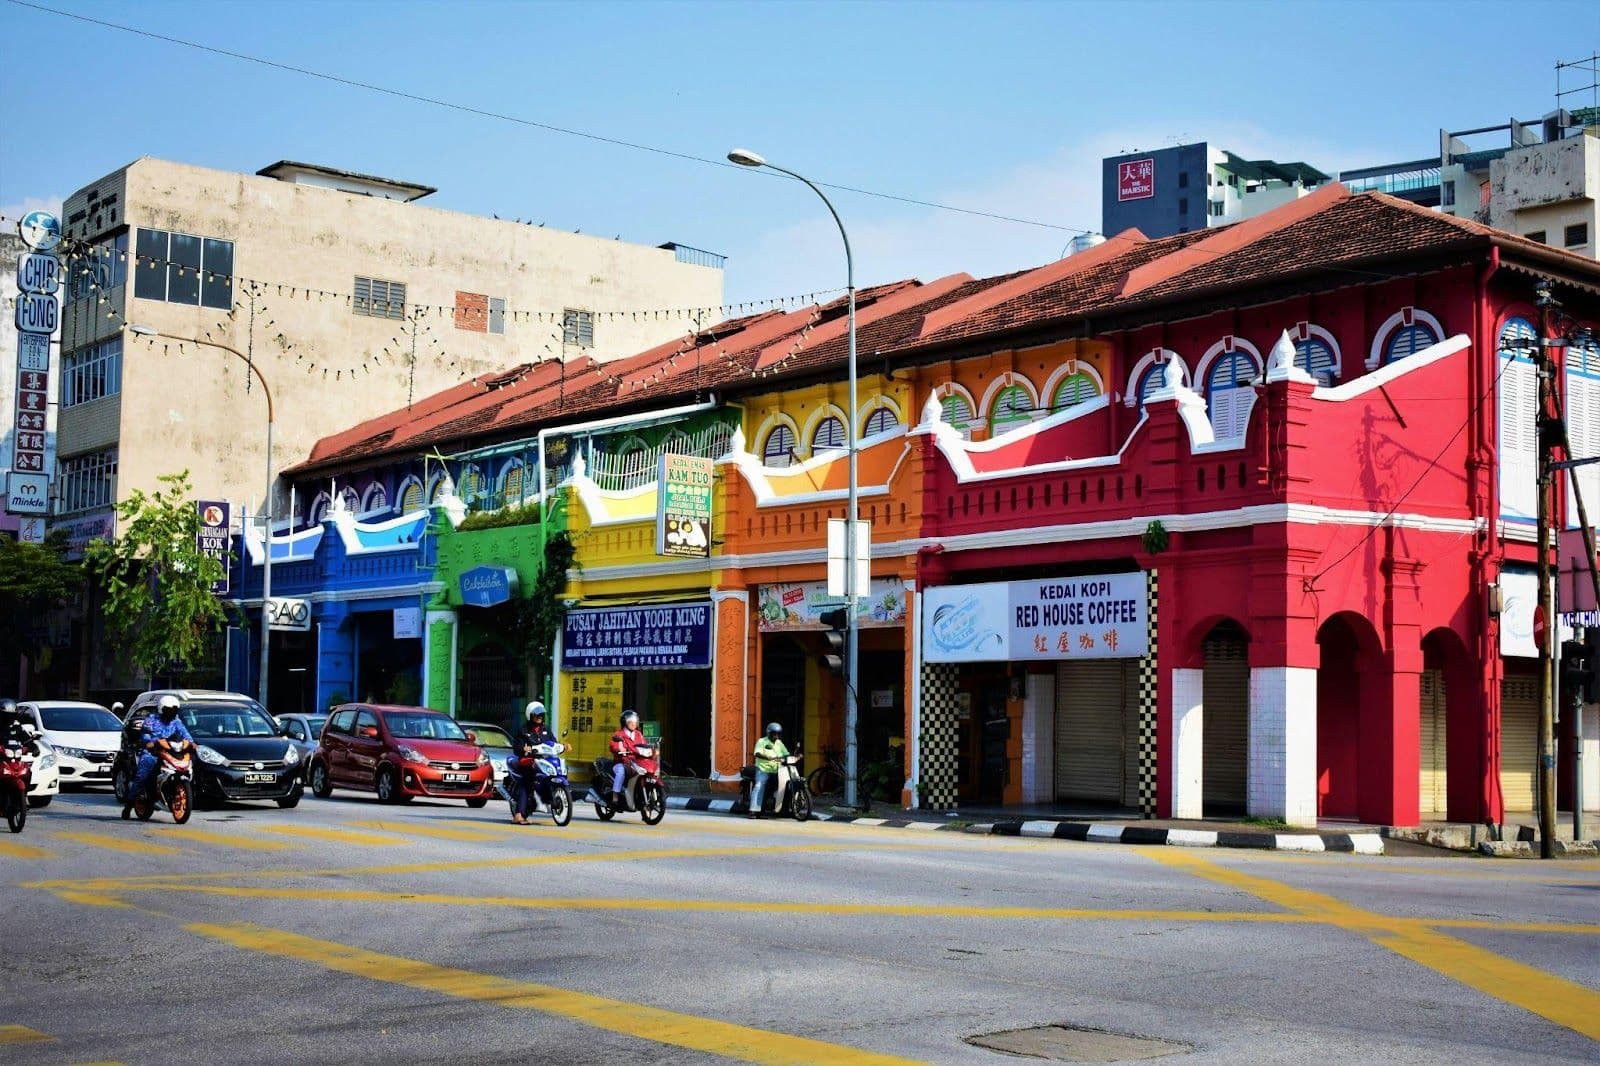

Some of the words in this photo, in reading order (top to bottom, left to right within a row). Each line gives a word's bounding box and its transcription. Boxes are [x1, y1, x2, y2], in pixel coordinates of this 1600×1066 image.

[1122, 185, 1150, 194] MAJESTIC
[25, 257, 54, 289] CHIP
[22, 299, 54, 329] FONG
[669, 469, 688, 481] KAM
[692, 471, 708, 484] TUO
[203, 537, 223, 549] KOK
[1040, 583, 1076, 600] KEDAI
[1081, 581, 1111, 598] KOPI
[566, 613, 597, 632] PUSAT
[598, 611, 642, 631] JAHITAN
[644, 609, 673, 628] YOOH
[675, 607, 706, 626] MING
[1016, 605, 1039, 628] RED
[1043, 602, 1084, 626] HOUSE
[1088, 600, 1137, 625] COFFEE
[1033, 629, 1118, 653] 紅屋咖啡
